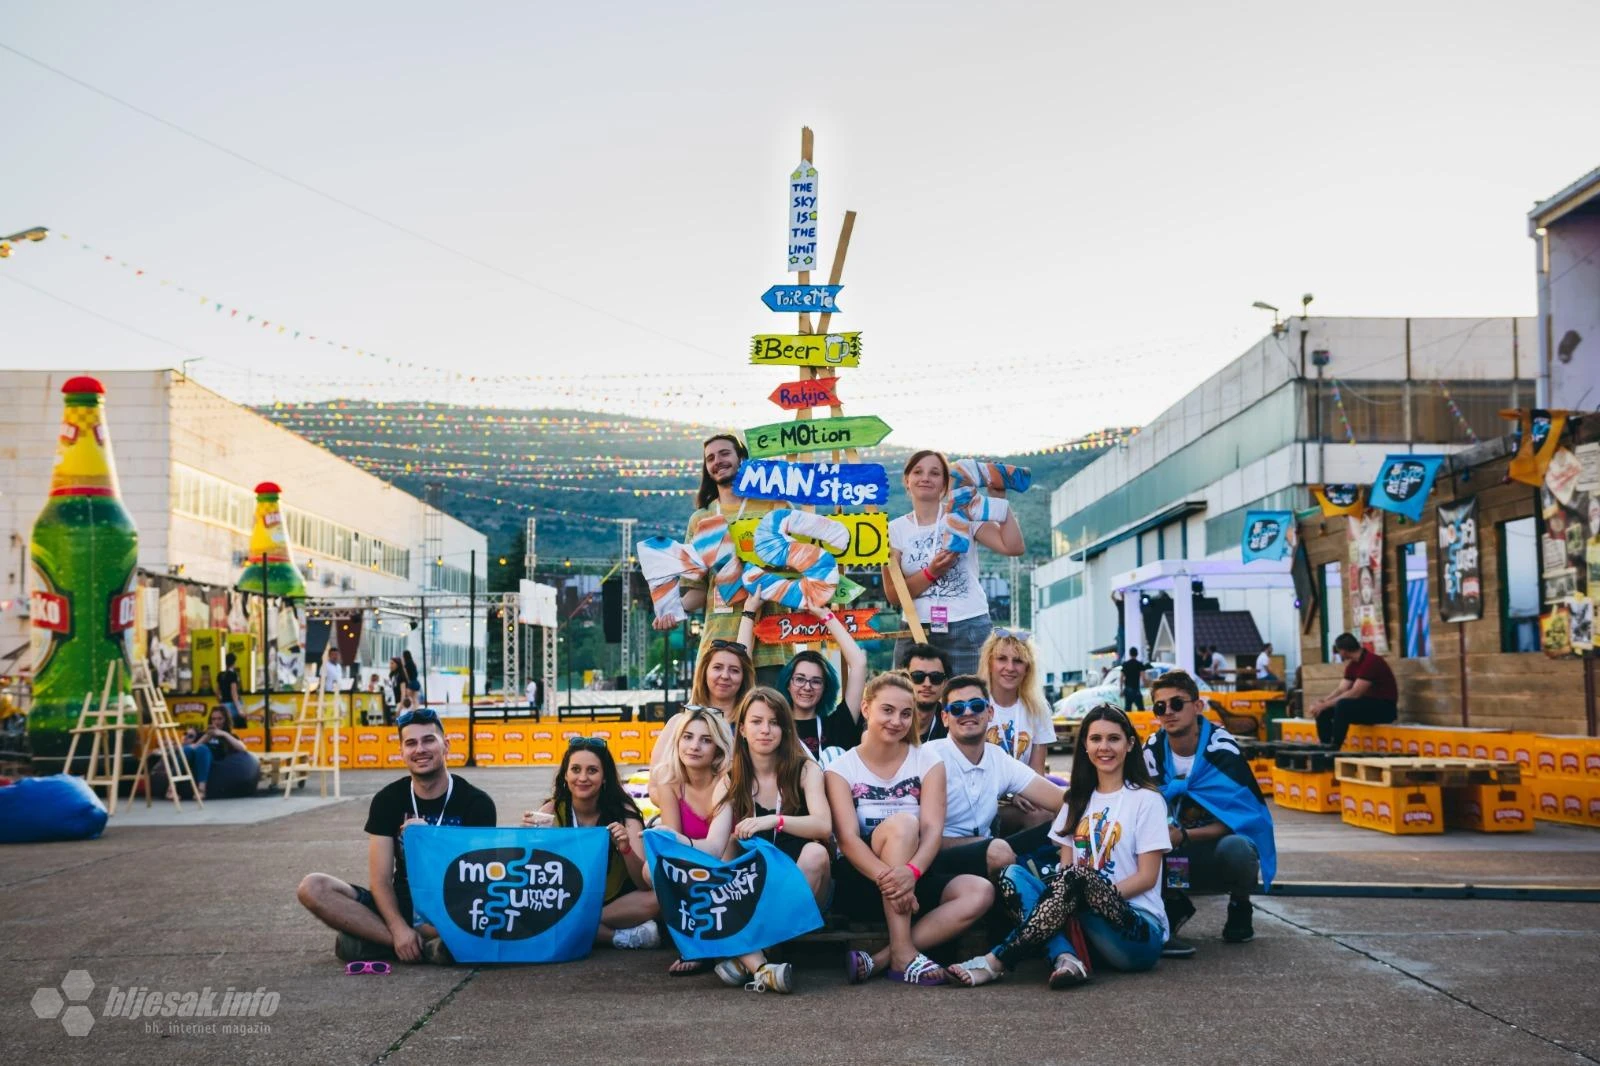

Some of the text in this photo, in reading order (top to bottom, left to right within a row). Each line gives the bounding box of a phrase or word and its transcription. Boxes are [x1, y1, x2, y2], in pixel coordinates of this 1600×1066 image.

[792, 183, 812, 192] THE
[793, 196, 816, 208] SKY
[796, 212, 808, 224] IS
[791, 227, 816, 238] THE
[759, 338, 820, 359] Beer
[780, 388, 829, 407] Rakija
[757, 424, 851, 448] e-MOtion
[739, 465, 815, 497] MAIN
